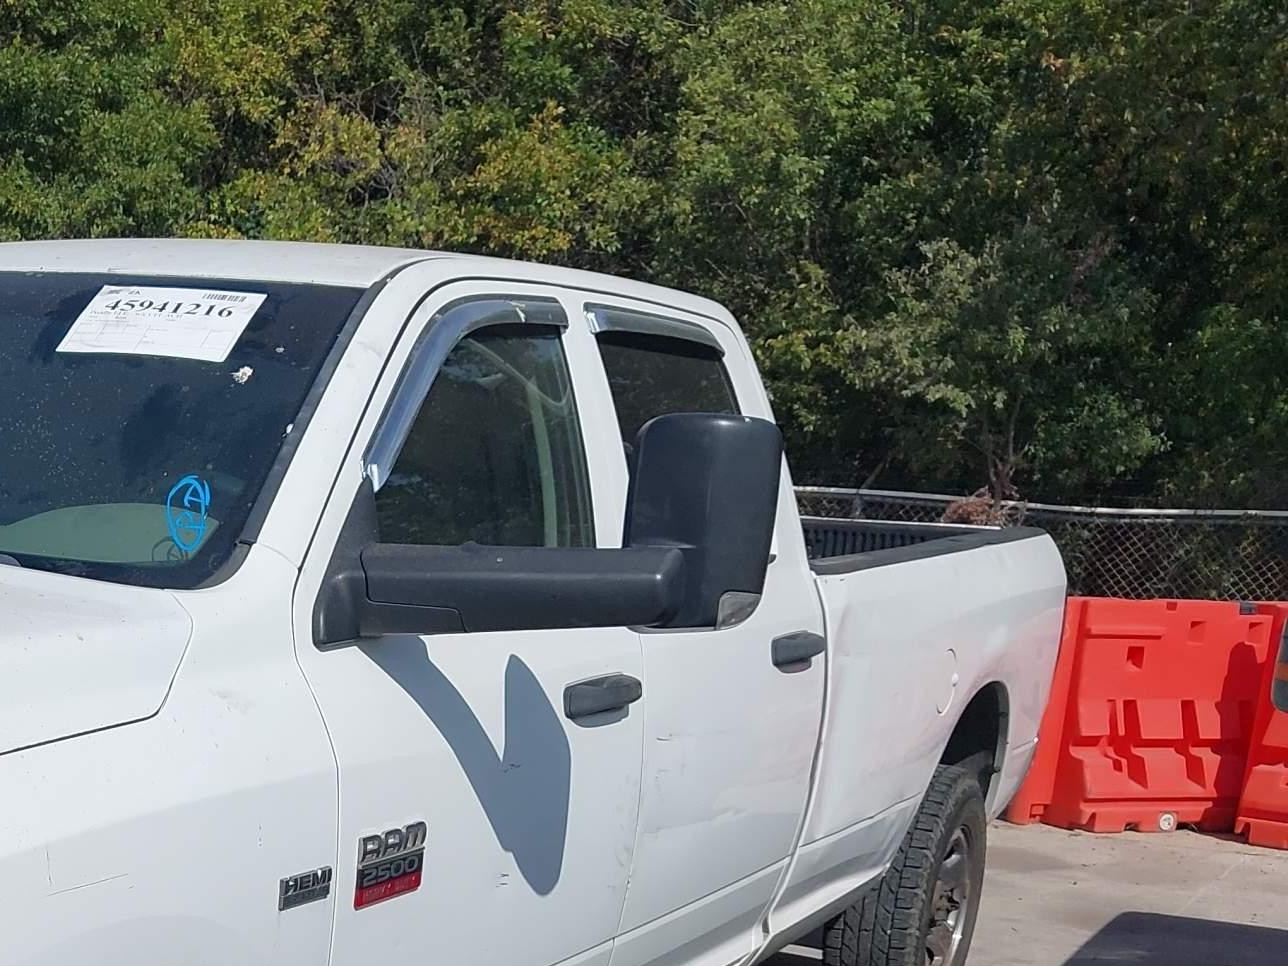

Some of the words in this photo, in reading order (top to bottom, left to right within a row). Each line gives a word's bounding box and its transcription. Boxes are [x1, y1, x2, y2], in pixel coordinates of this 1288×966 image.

[104, 299, 233, 319] 45941216
[358, 821, 427, 867] RAM
[279, 866, 332, 897] HEMI
[362, 856, 419, 887] 2500
